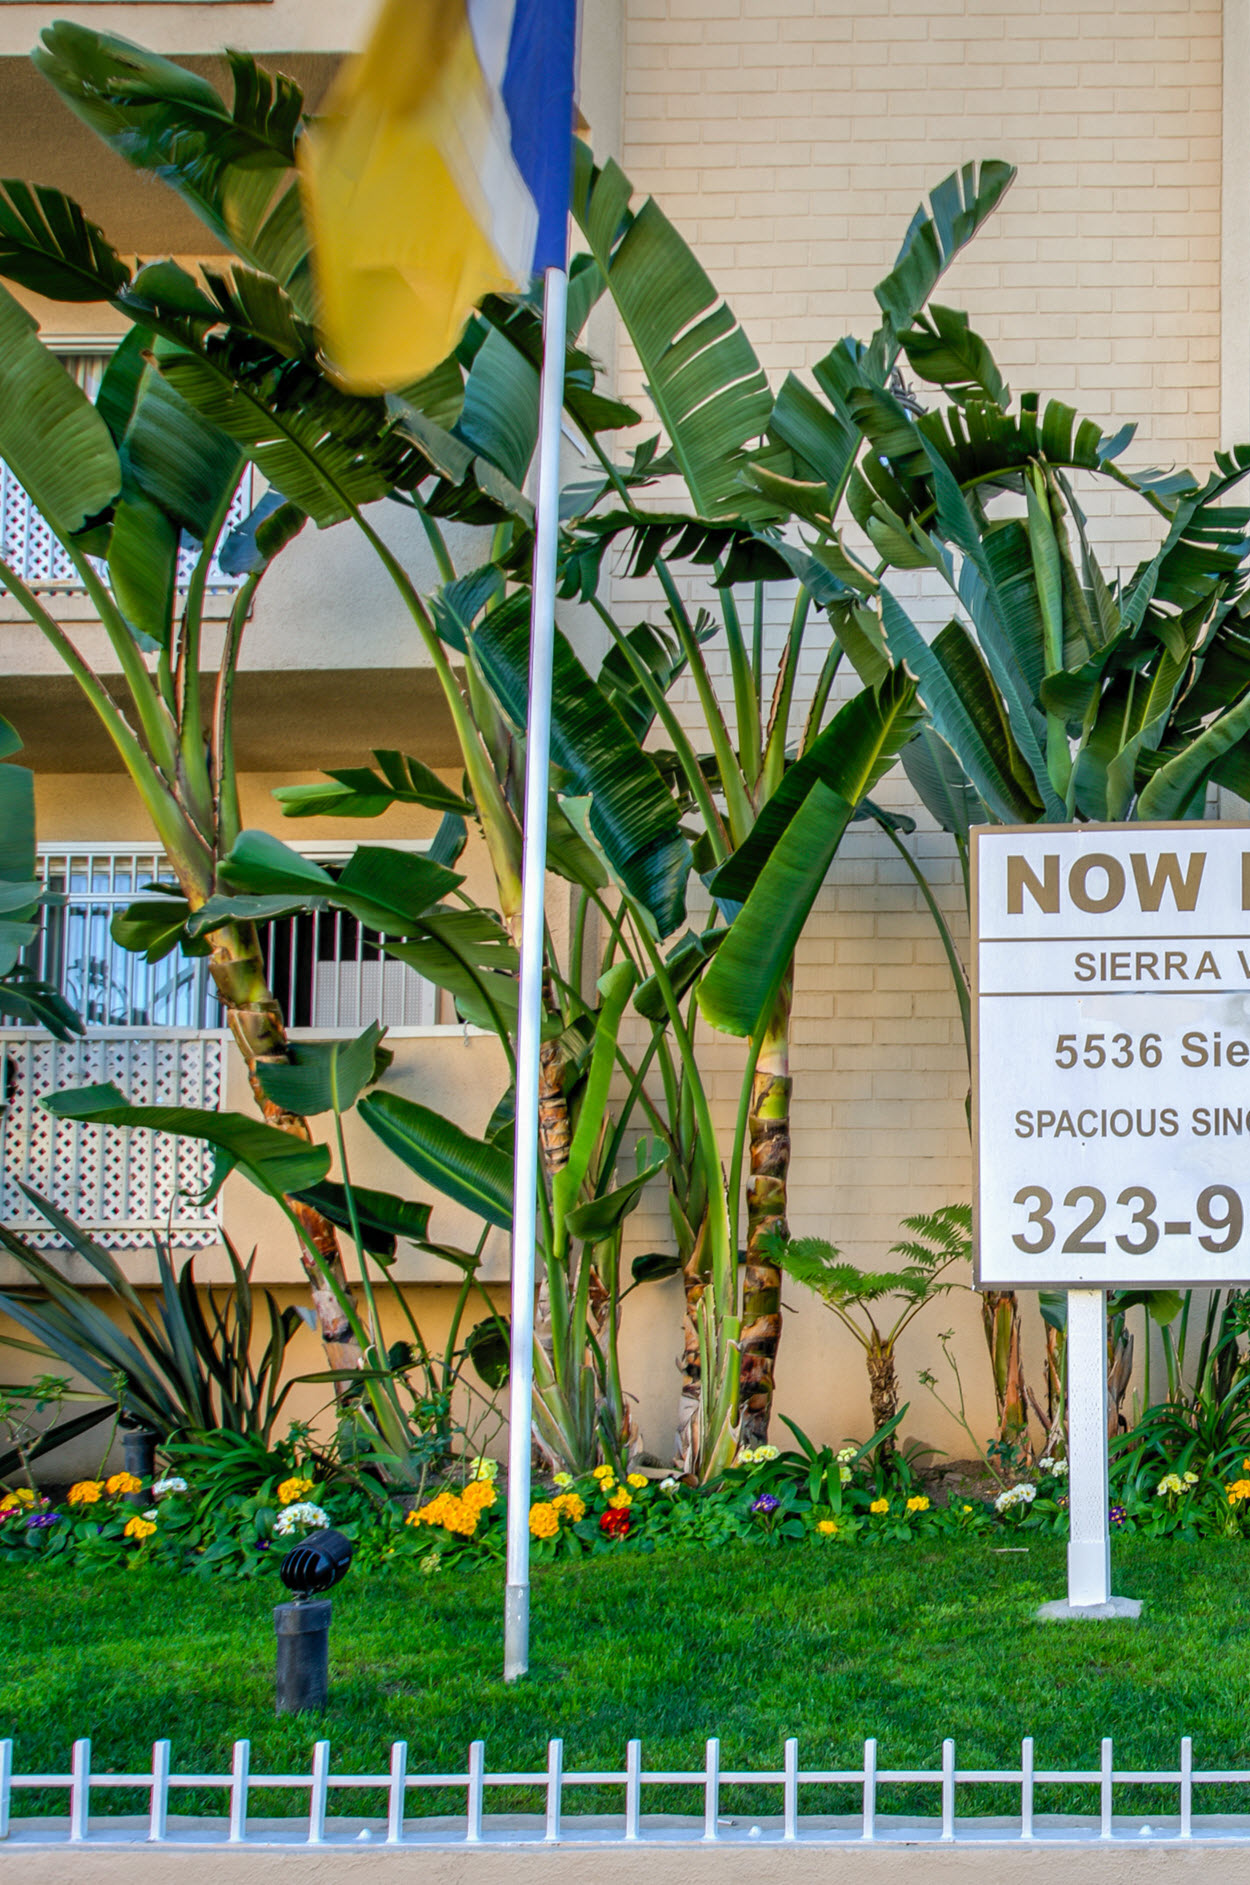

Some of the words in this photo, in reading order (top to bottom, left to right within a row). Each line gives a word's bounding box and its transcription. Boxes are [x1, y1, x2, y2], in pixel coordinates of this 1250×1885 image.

[1007, 852, 1207, 915] NOW
[1074, 951, 1222, 982] SIERRA
[1055, 1033, 1163, 1070] 5536
[1014, 1108, 1179, 1138] SPACIOUS
